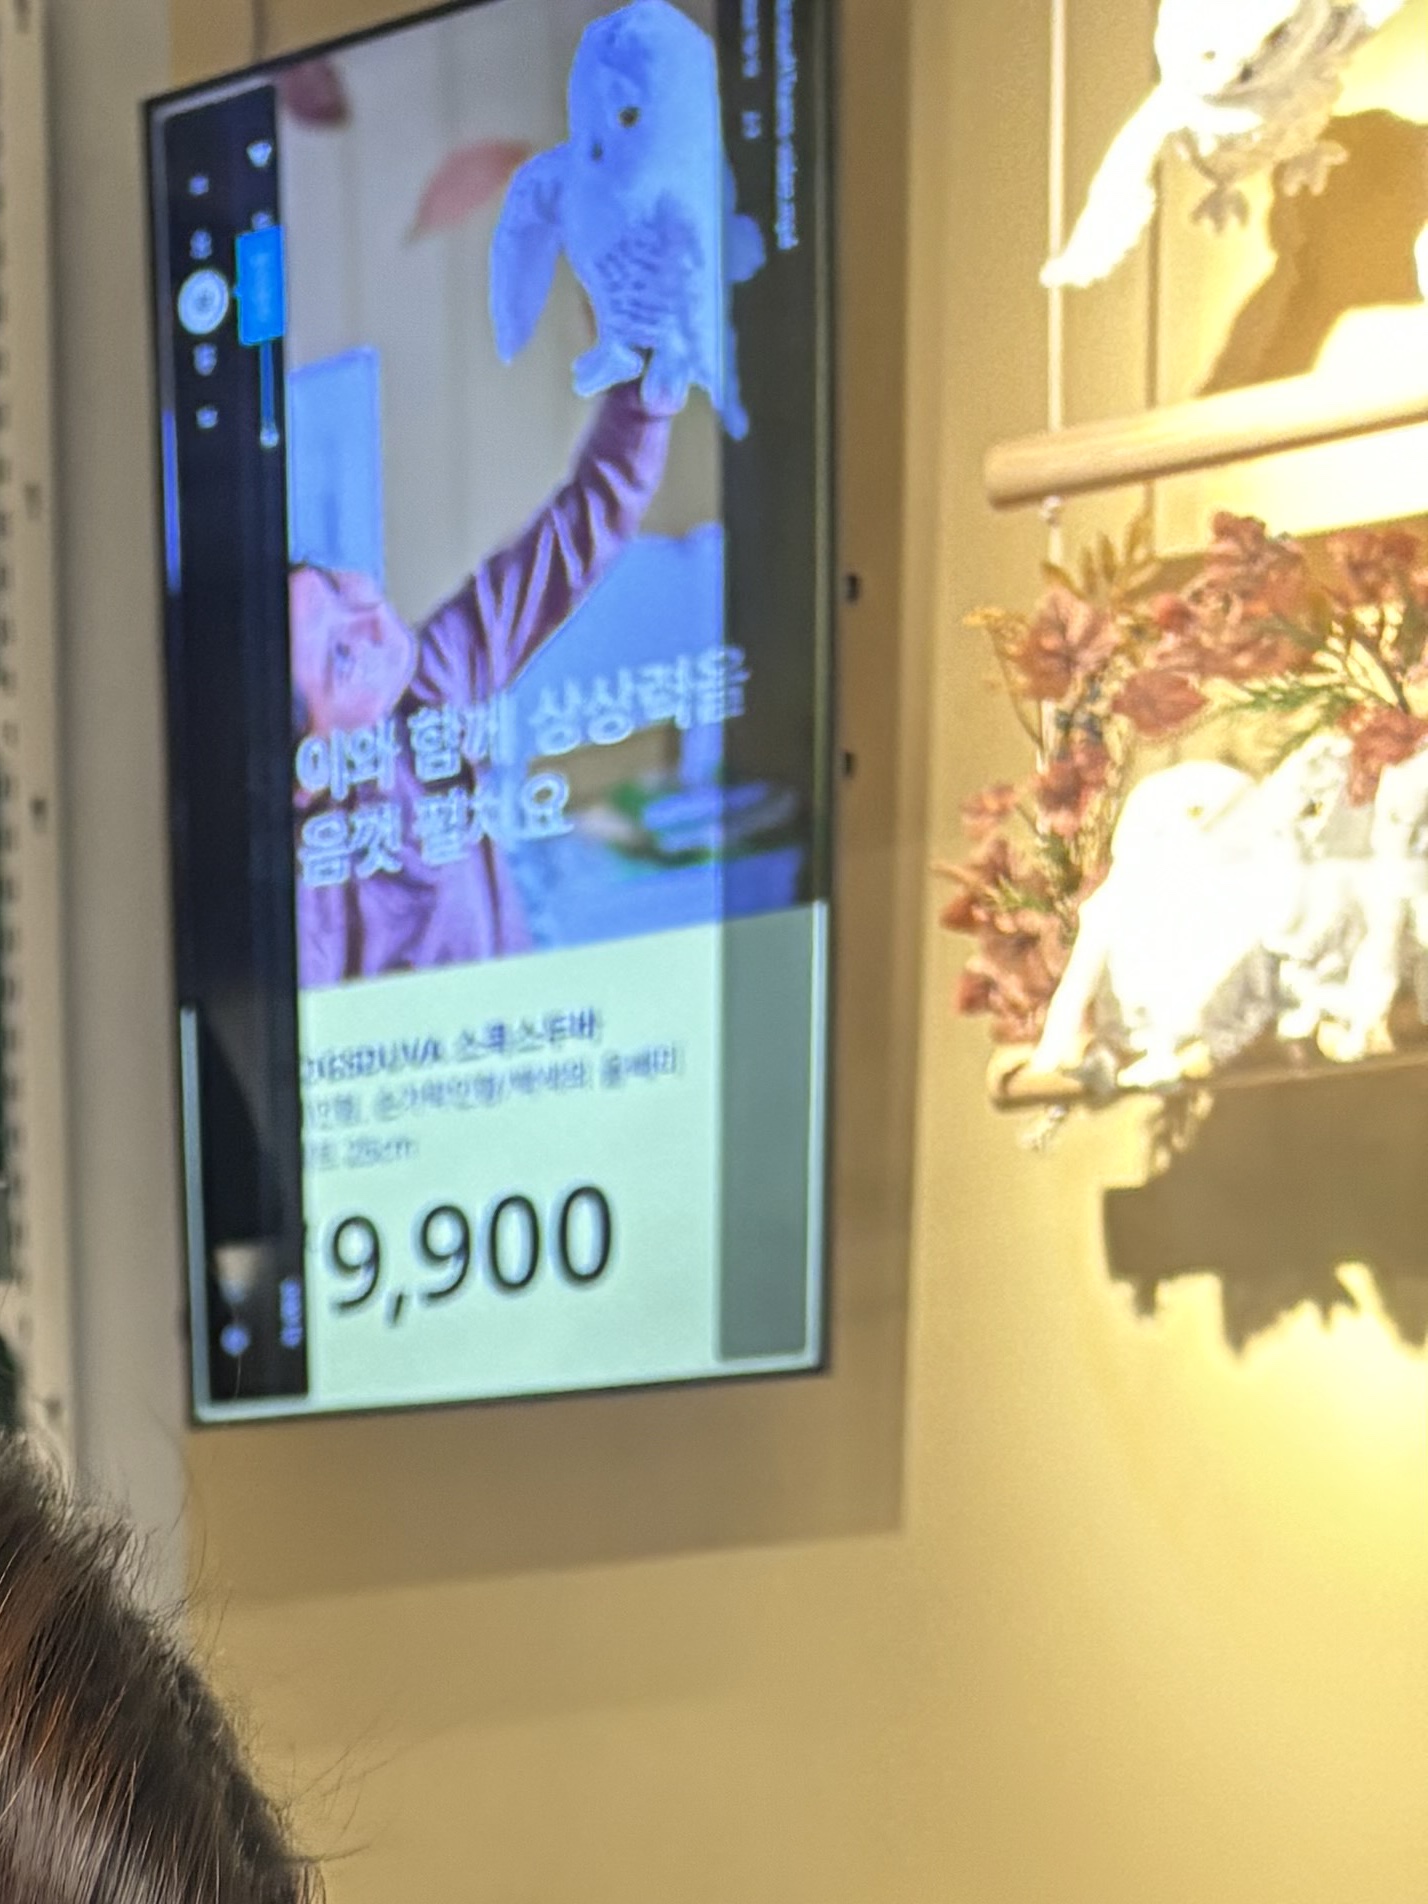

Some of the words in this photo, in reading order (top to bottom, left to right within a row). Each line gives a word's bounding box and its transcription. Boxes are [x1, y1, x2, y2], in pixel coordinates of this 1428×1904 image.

[407, 694, 518, 782] 함께
[532, 645, 750, 756] 상상력을
[332, 1185, 612, 1328] 9,900
